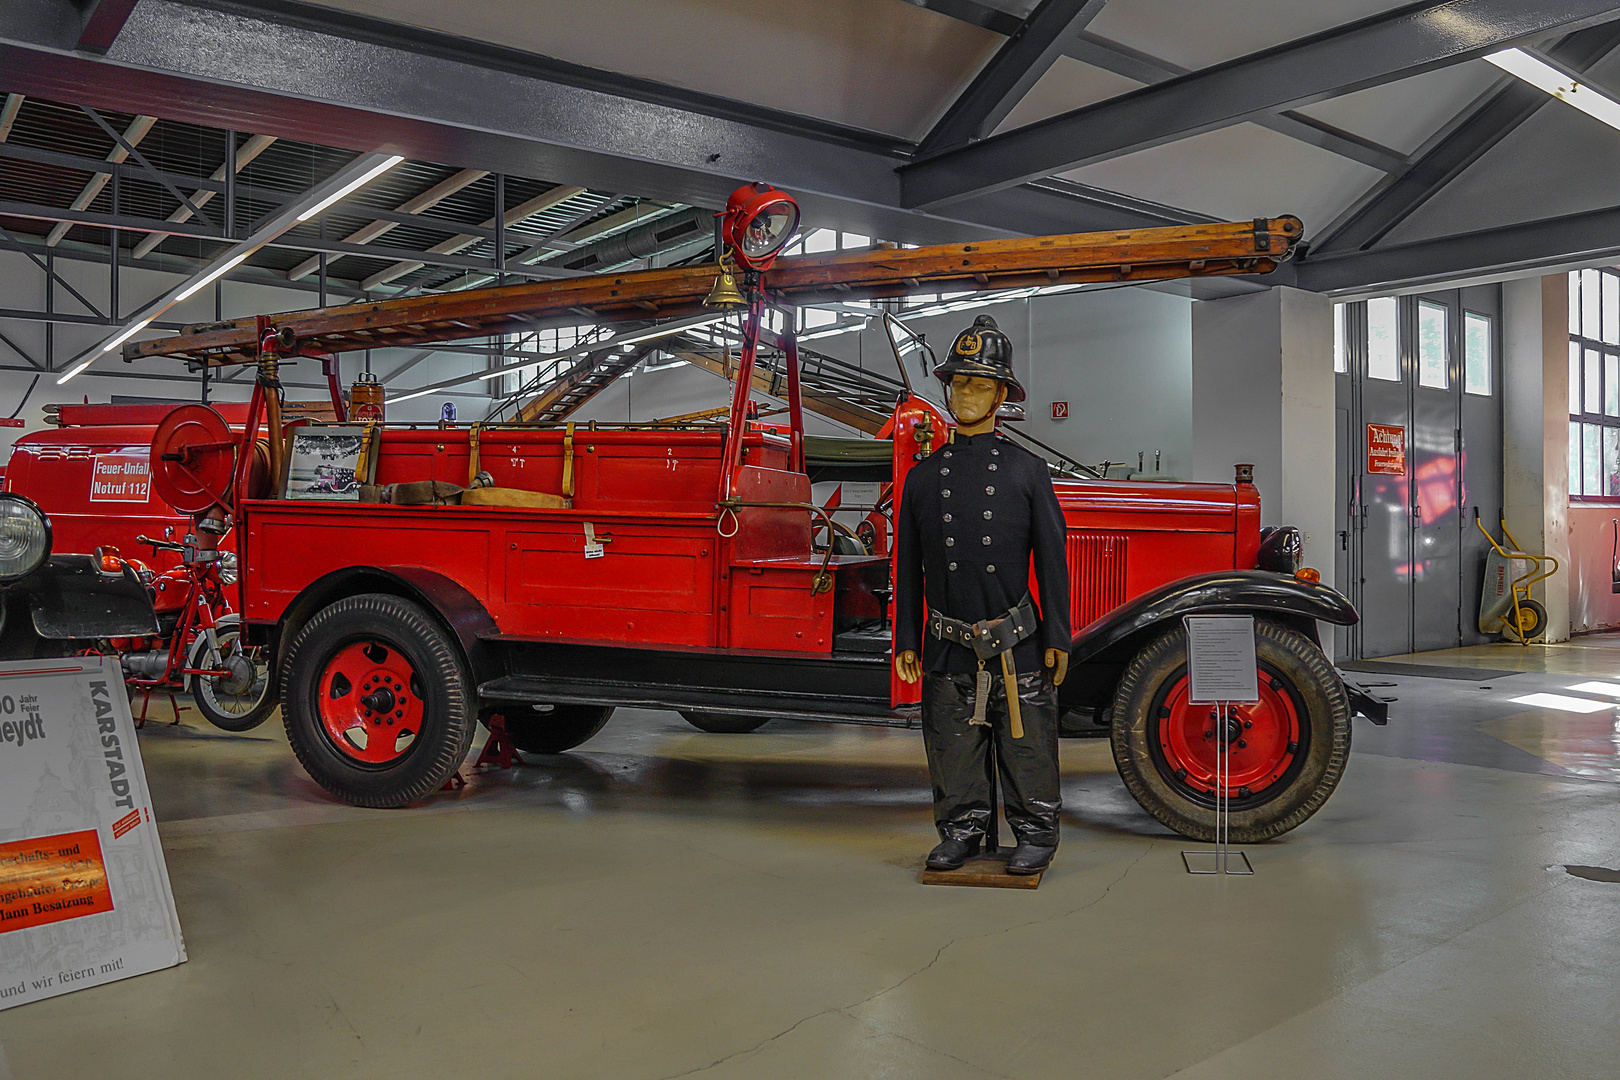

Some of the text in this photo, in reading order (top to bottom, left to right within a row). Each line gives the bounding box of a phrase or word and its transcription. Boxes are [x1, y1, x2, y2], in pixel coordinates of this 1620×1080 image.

[96, 462, 150, 475] Feuer-Unfall
[94, 482, 147, 495] Notruf 112
[0, 694, 38, 715] 0 Jahr
[20, 704, 40, 713] Feier
[89, 681, 134, 809] KARSTADT
[58, 843, 80, 857] und
[32, 895, 94, 915] Besatzung
[0, 957, 124, 999] und wir feiern mit!
